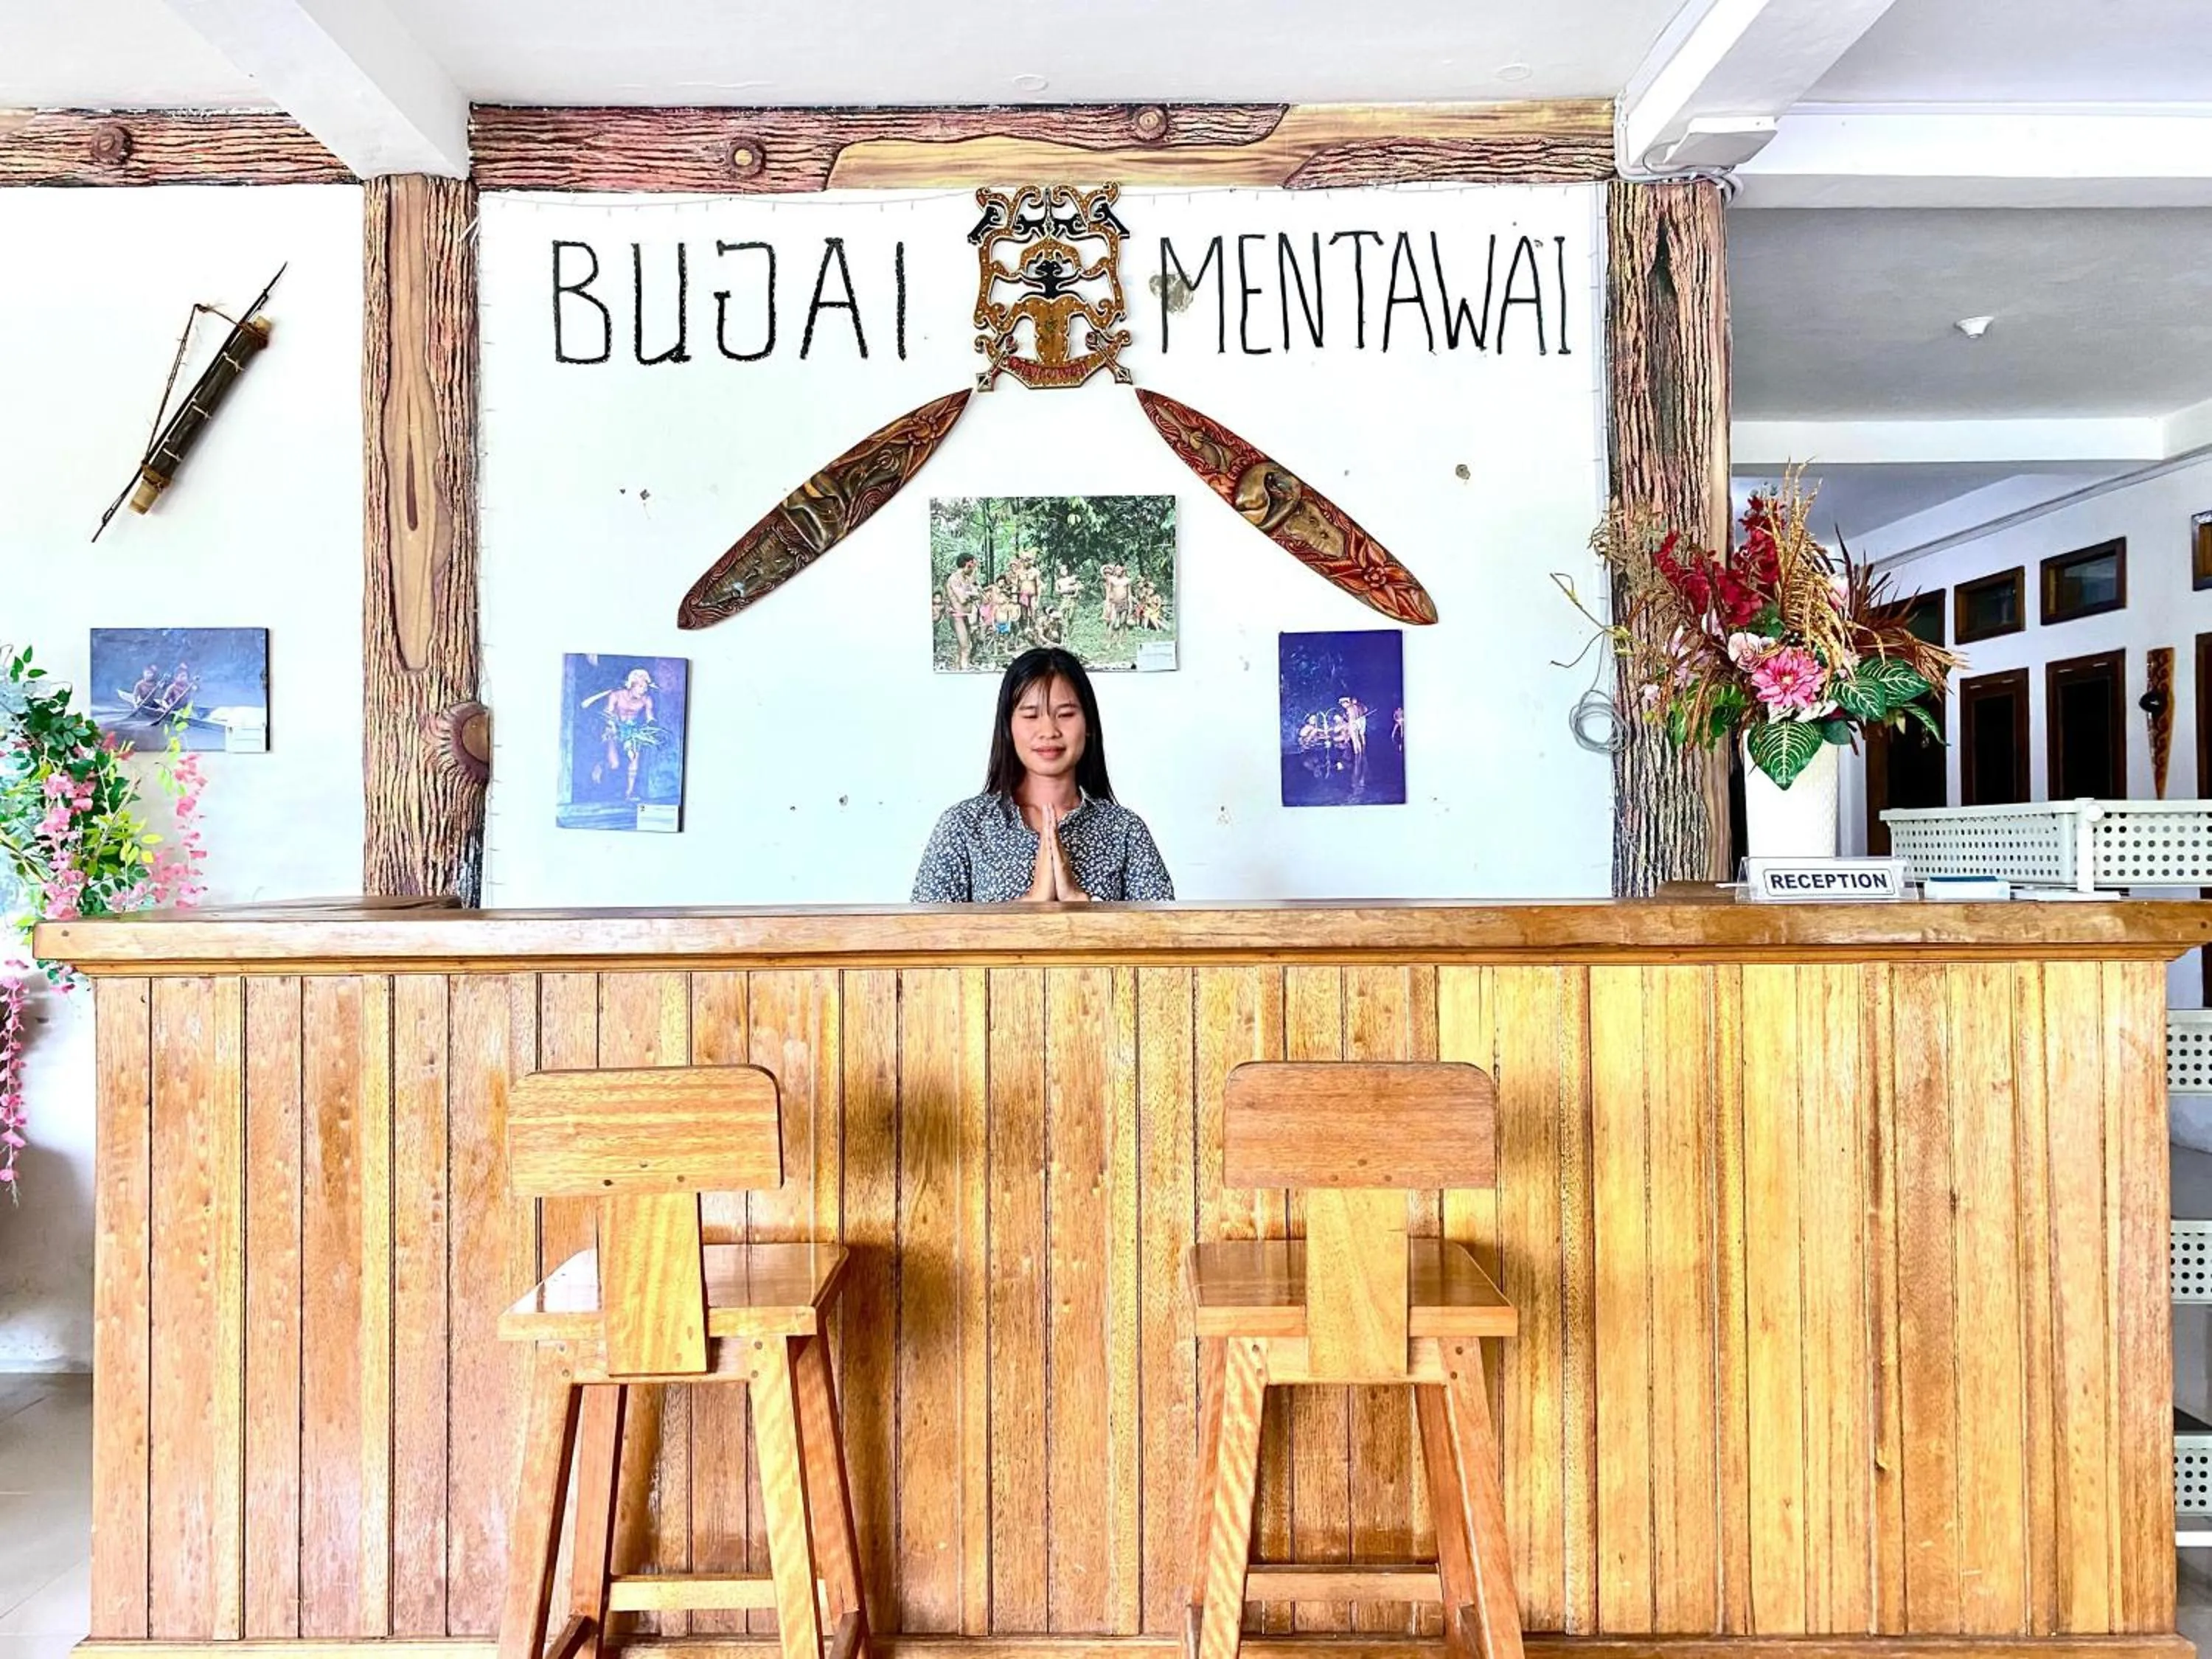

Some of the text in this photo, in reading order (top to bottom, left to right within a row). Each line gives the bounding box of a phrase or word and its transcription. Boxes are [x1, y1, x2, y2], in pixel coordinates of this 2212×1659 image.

[552, 230, 1571, 366] BUJAI MENTAWAI
[1770, 873, 1888, 889] RECEPTION
